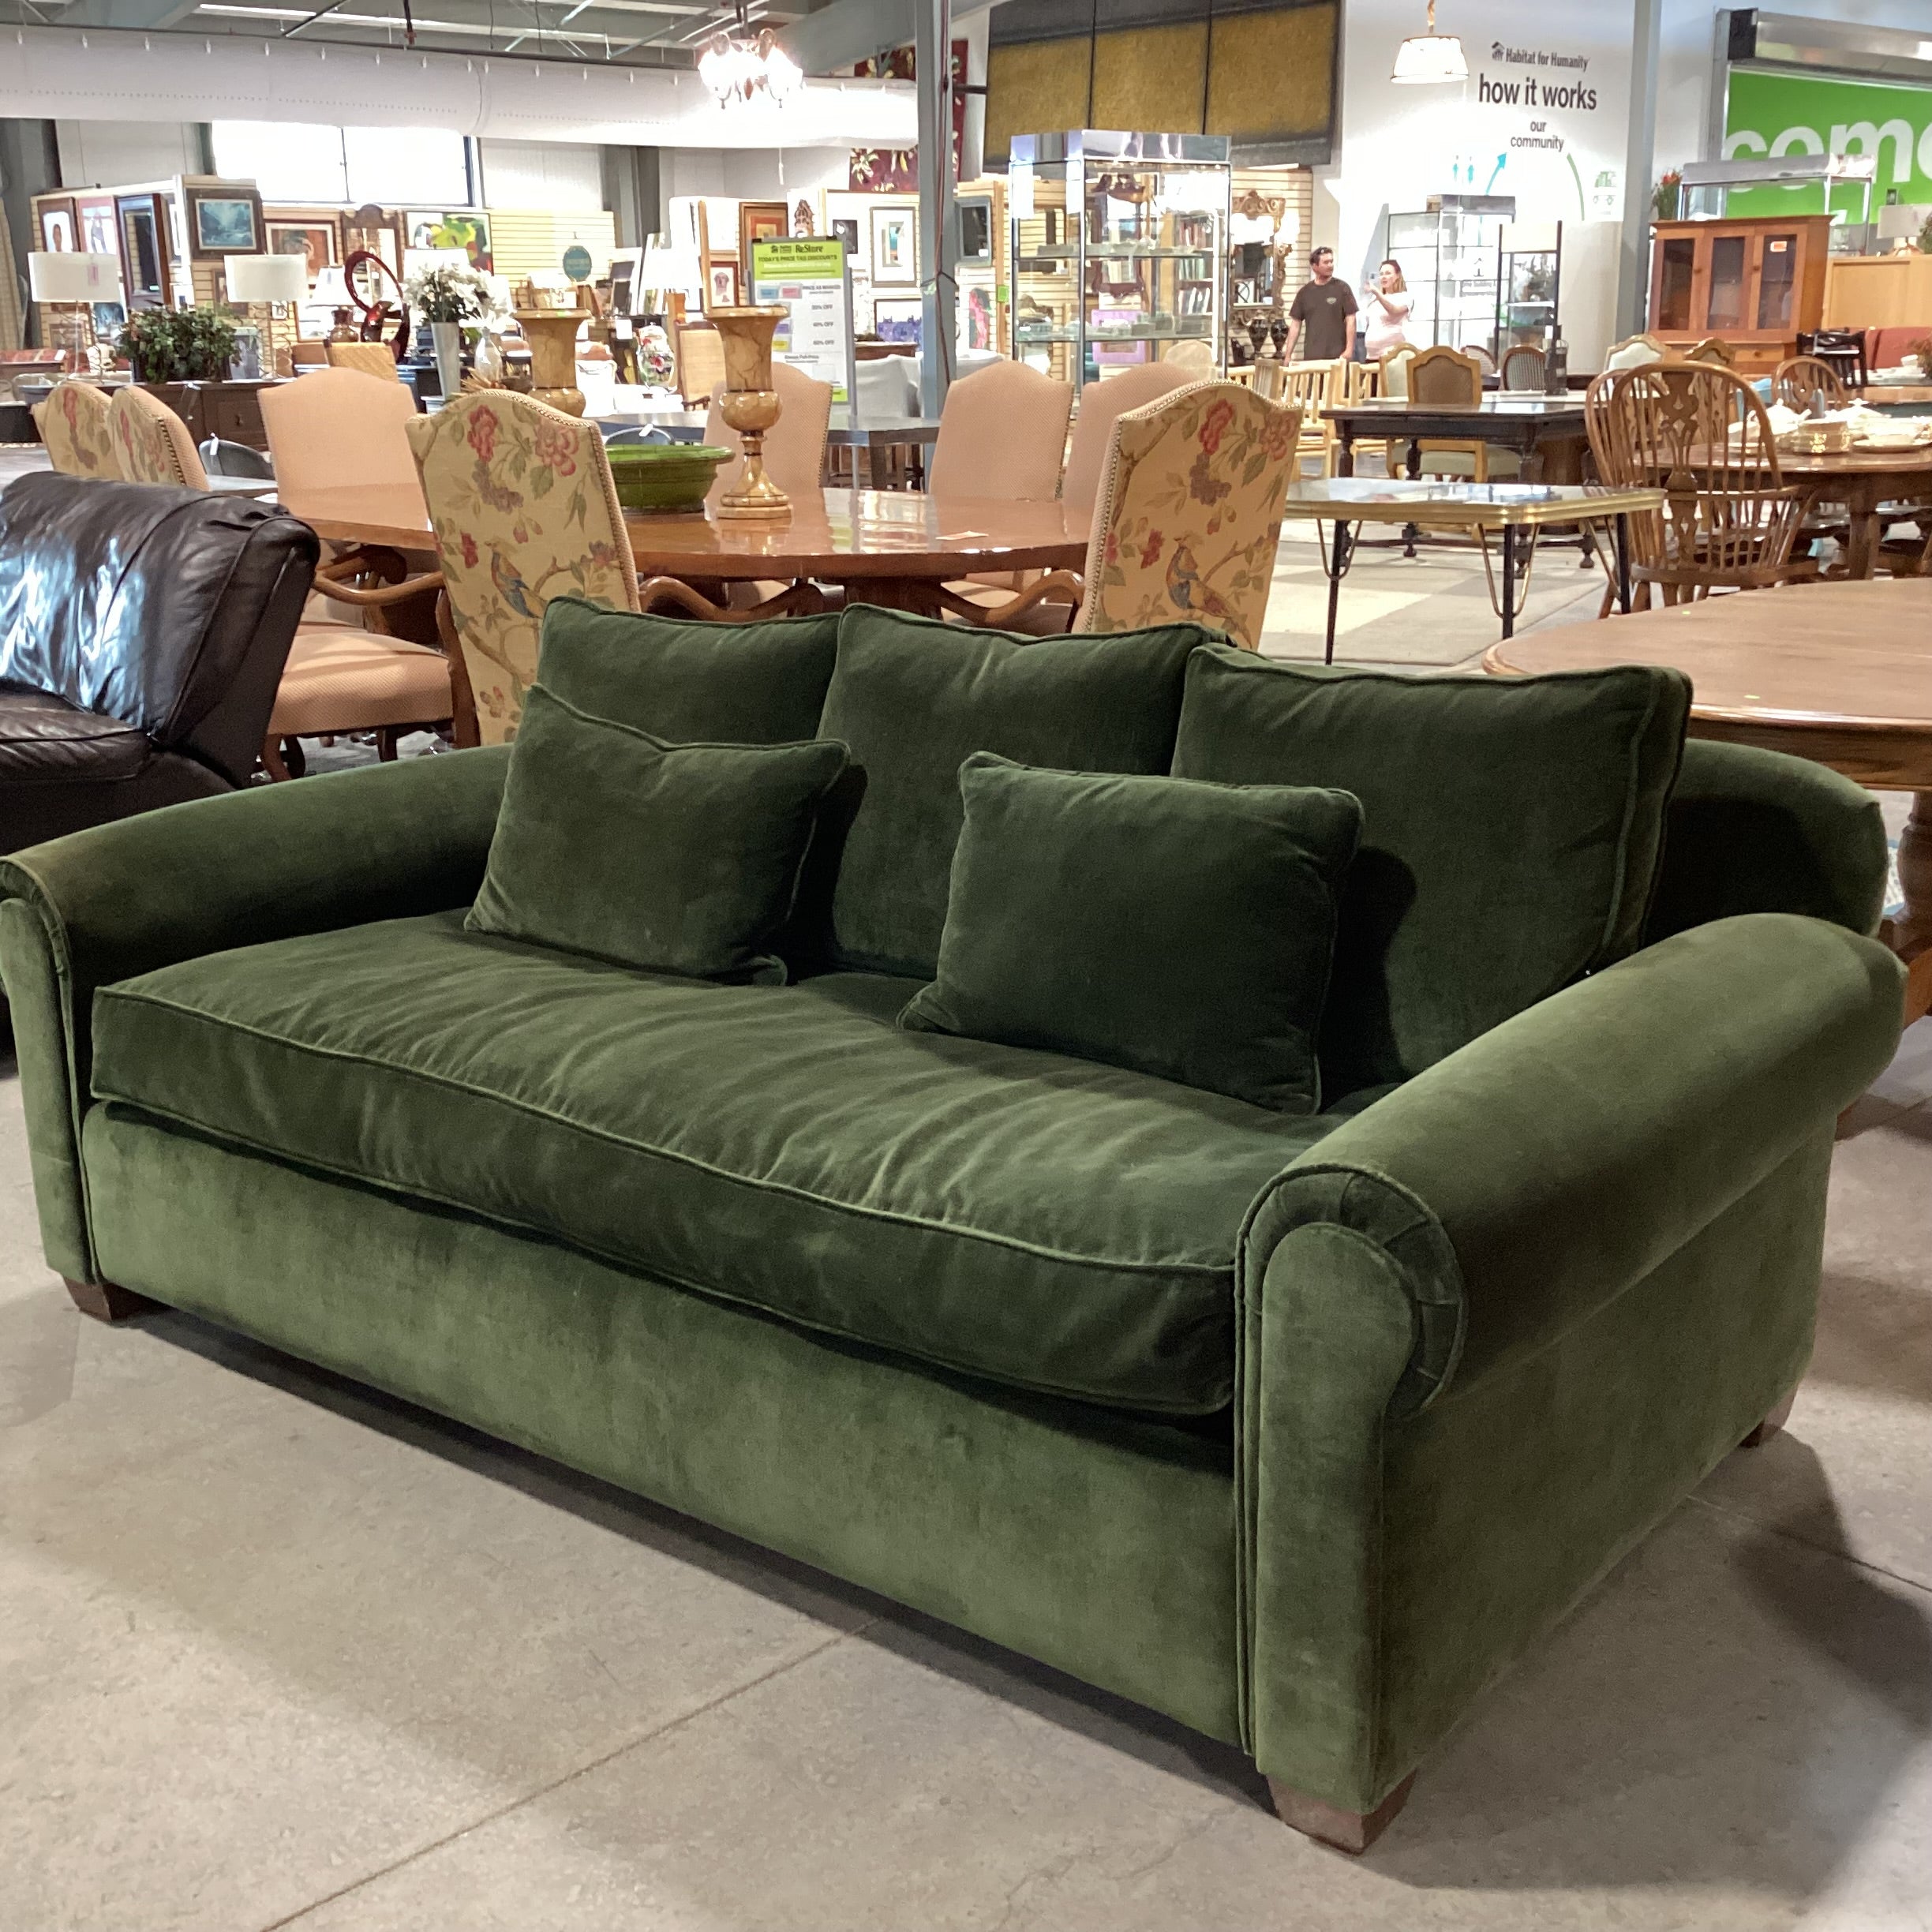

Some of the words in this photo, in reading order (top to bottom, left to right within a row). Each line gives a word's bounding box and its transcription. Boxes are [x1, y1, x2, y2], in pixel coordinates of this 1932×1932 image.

[1506, 47, 1536, 65] Habitat
[1537, 51, 1549, 66] for
[1551, 52, 1591, 72] Humanity
[1479, 73, 1520, 104] how
[1525, 77, 1537, 107] it
[1542, 80, 1597, 110] works
[1530, 121, 1547, 133] our
[1511, 135, 1564, 152] community
[1721, 119, 1932, 193] com
